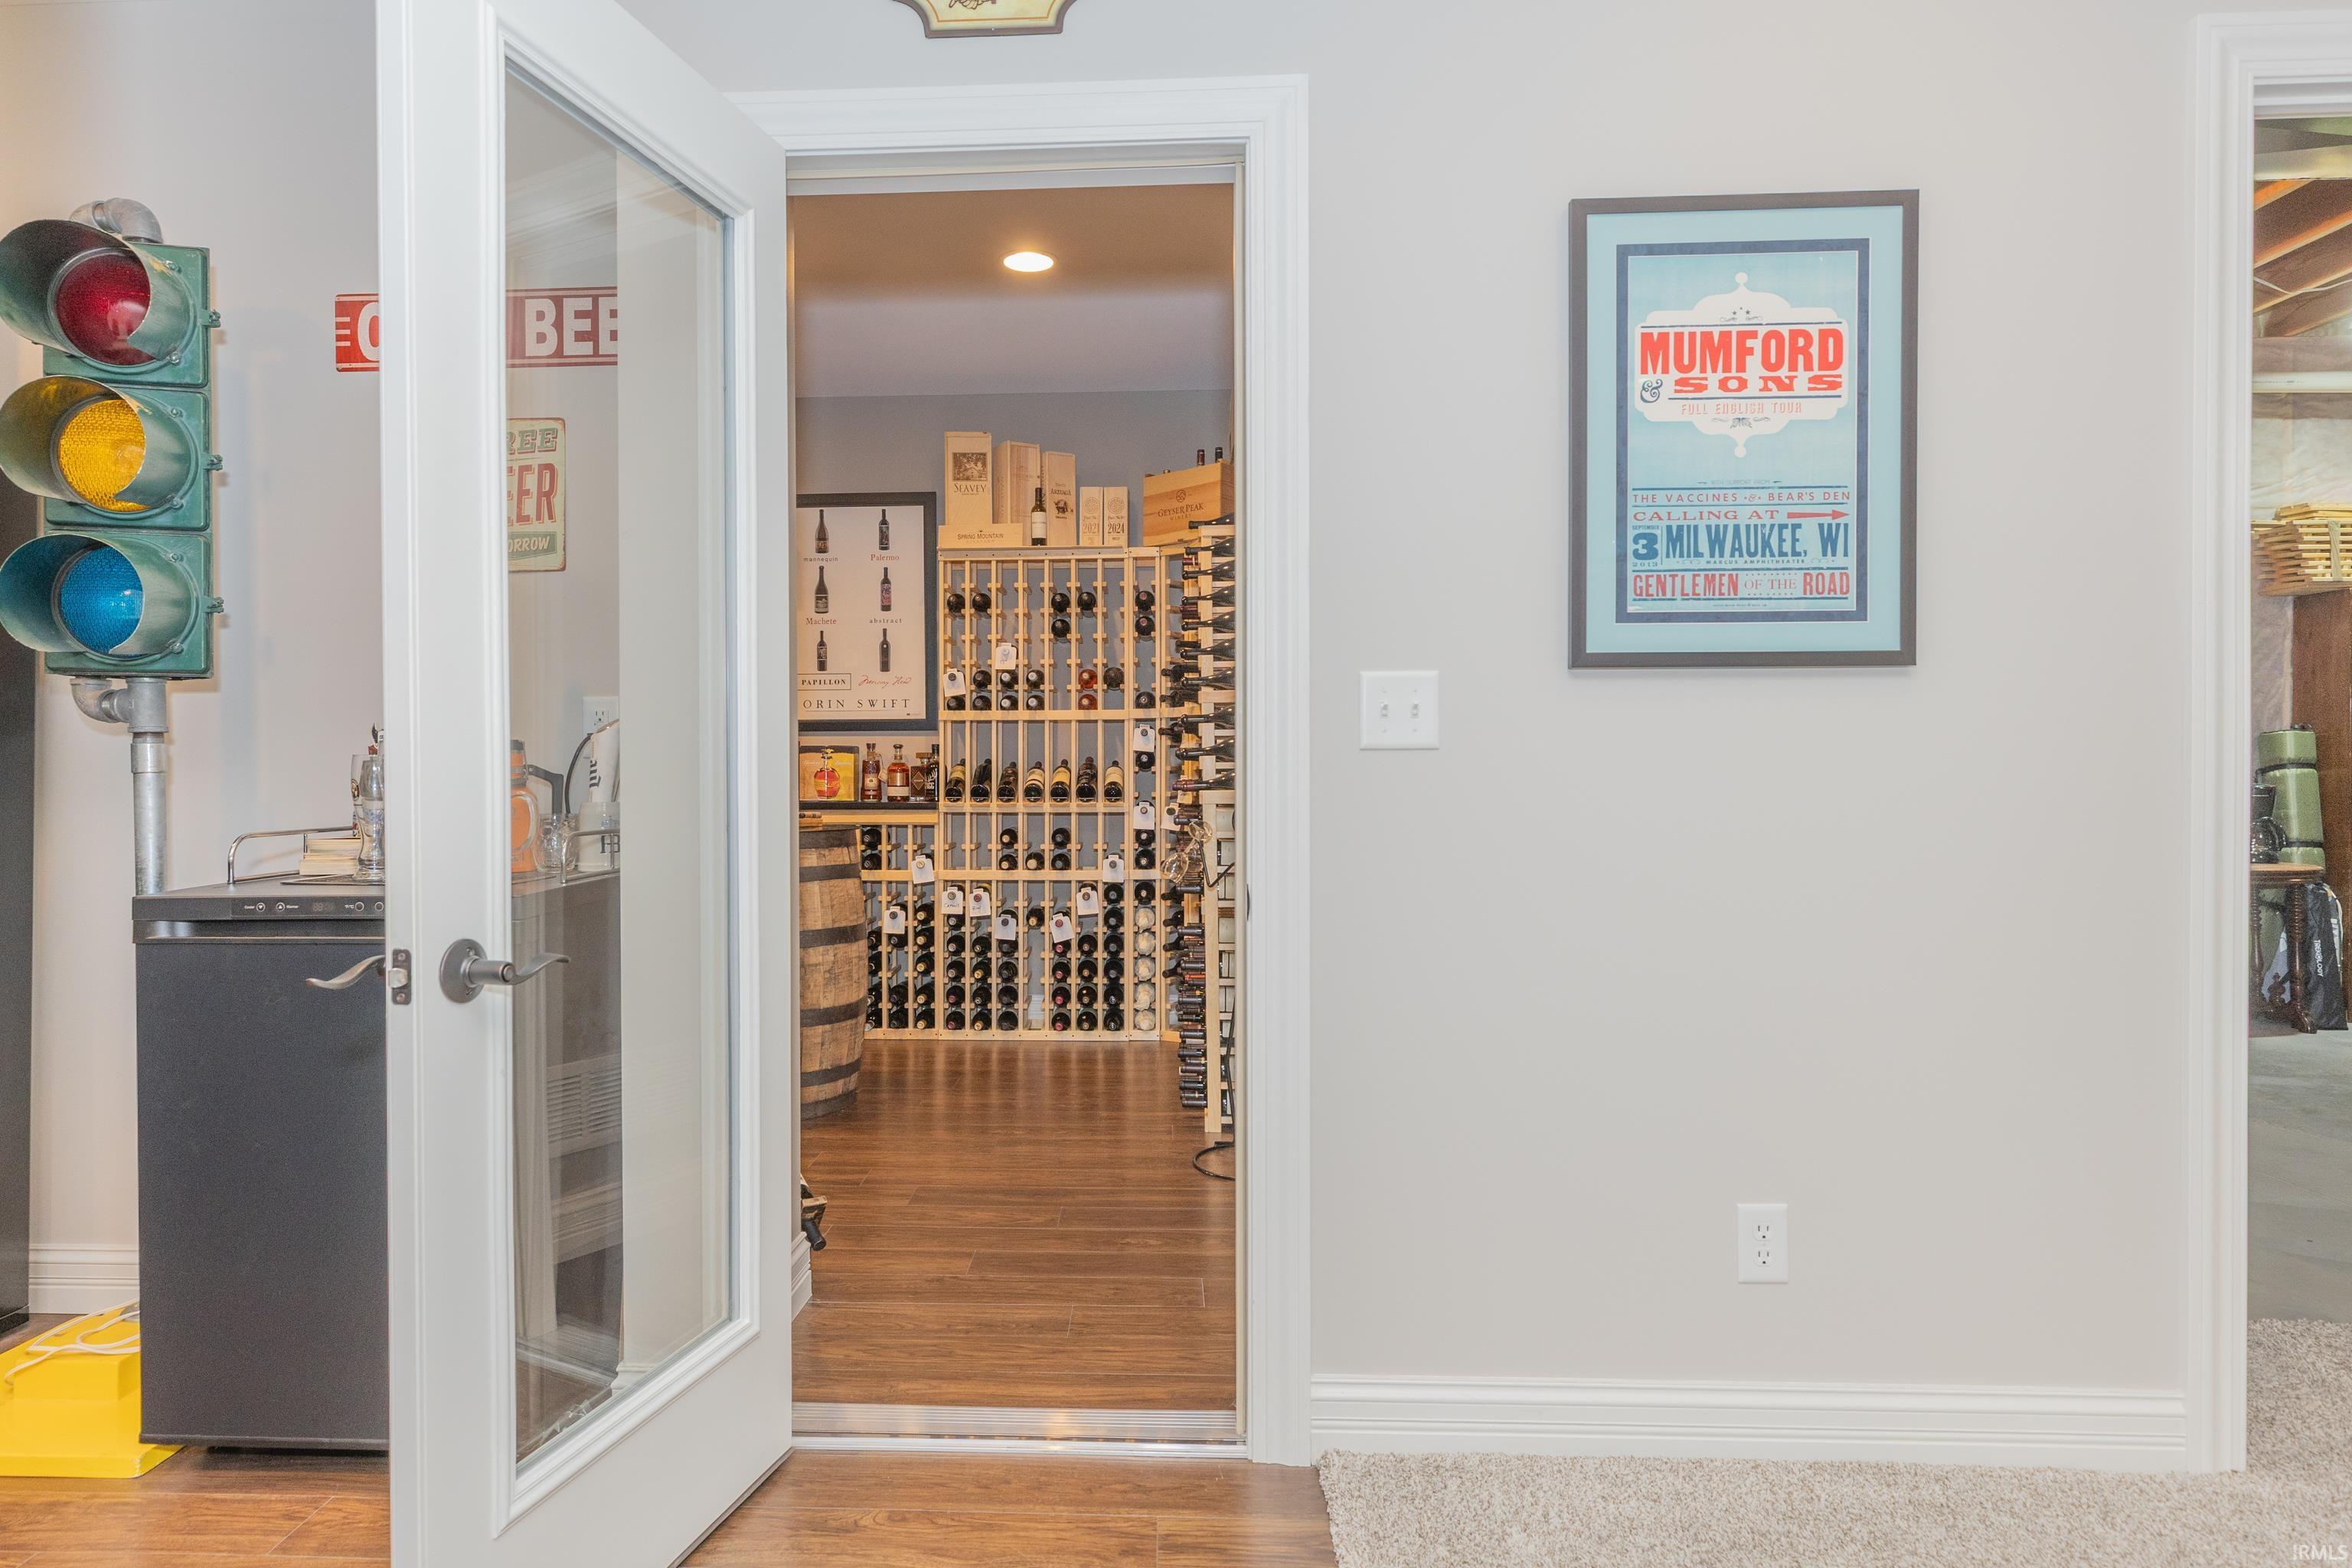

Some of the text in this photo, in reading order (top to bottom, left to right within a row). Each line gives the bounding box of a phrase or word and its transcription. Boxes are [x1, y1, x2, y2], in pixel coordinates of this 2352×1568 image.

[524, 296, 618, 357] BEE
[1640, 328, 1844, 375] MUMFORD
[1640, 374, 1842, 403] & SONS
[1681, 401, 1802, 415] FULL ENGLISH TOUR
[506, 427, 558, 456] REE
[954, 482, 987, 493] SEAVEY
[1632, 494, 1658, 503] THE
[1665, 492, 1738, 503] VACCINES
[1768, 492, 1815, 501] BEAR'S
[1823, 492, 1851, 501] DEN
[1158, 502, 1205, 518] GEYSER PEAK
[1632, 509, 1779, 521] CALLING AT
[508, 536, 550, 553] ORROW
[1632, 532, 1659, 560] 3
[1665, 522, 1849, 559] MILWAUKEE, WI
[871, 554, 900, 562] Palermo
[1633, 571, 1851, 597] GENTLEMEN OF THE ROAD
[805, 617, 838, 626] Machete
[802, 698, 911, 709] ORIN SWIFT
